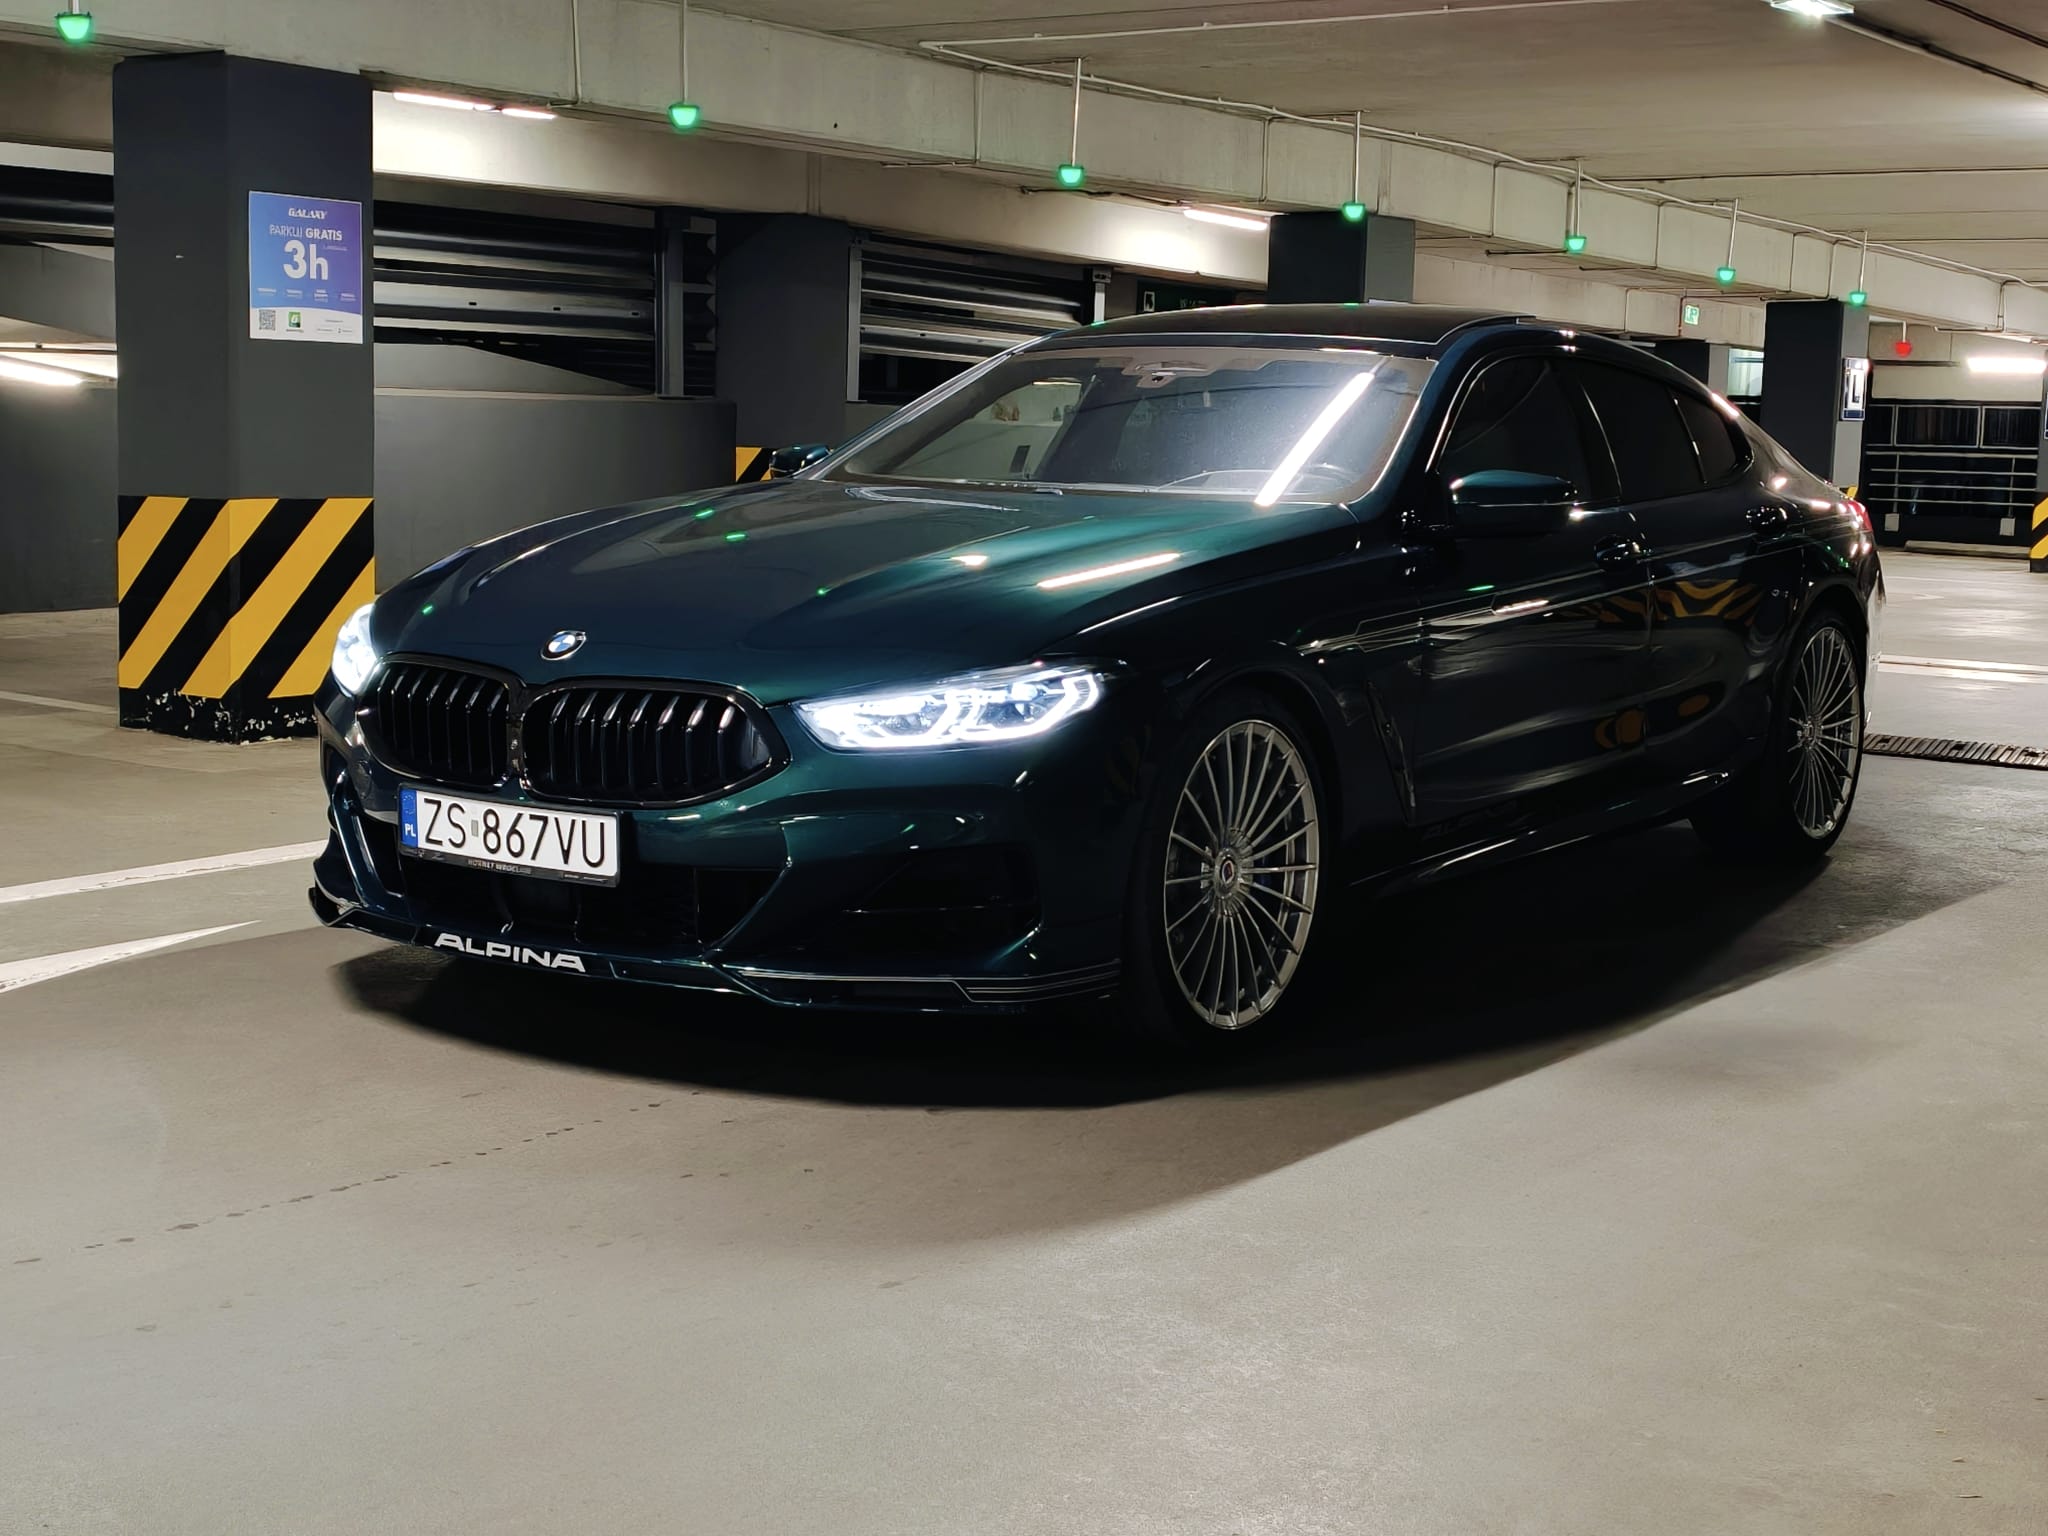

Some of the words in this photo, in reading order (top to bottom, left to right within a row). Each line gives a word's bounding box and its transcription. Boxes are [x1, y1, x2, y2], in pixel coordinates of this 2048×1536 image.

[288, 208, 327, 219] GALAXY
[305, 228, 343, 241] GRATIS
[283, 239, 329, 281] 3h
[404, 823, 417, 838] PL
[423, 798, 466, 849] ZS
[481, 808, 606, 868] 867VU
[434, 932, 586, 973] ALPINA
